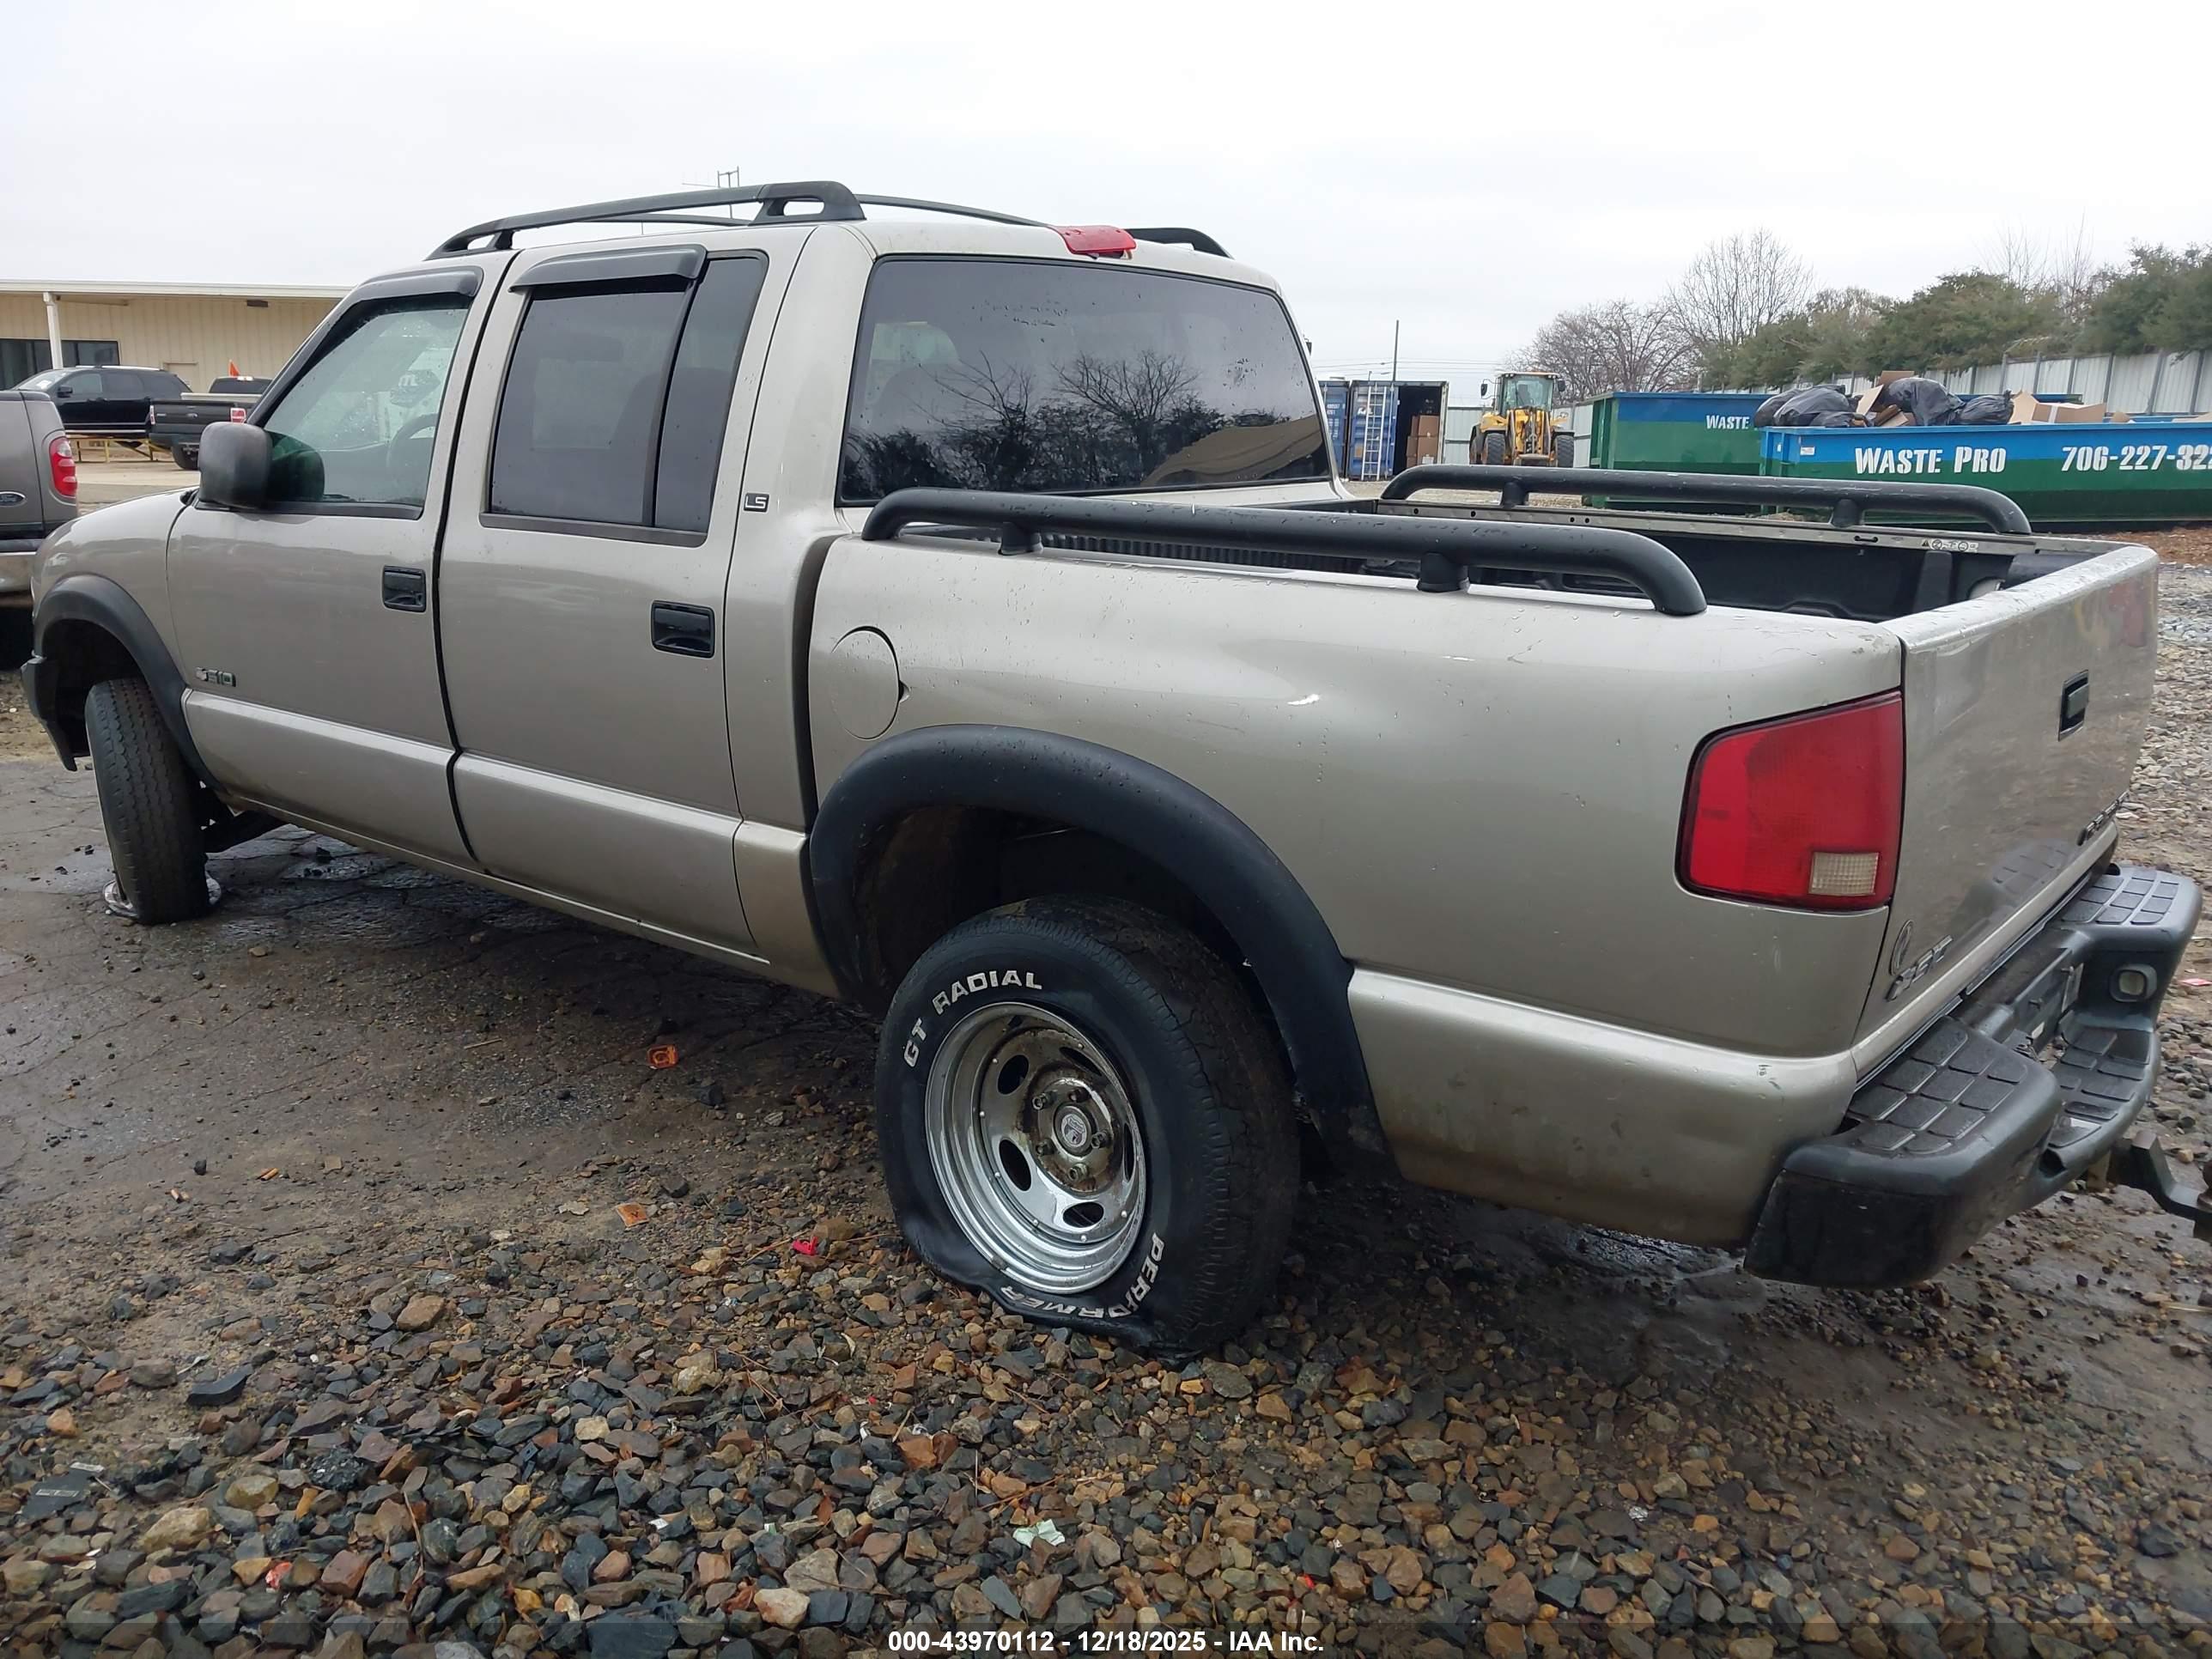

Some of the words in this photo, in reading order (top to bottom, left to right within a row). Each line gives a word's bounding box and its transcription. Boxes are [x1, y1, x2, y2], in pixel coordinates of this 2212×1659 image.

[1705, 414, 1750, 430] WASTE
[1854, 447, 1944, 474] WASTE
[1954, 446, 2008, 474] PRO
[2061, 444, 2212, 471] 706-227-32
[744, 495, 767, 509] LS
[902, 1017, 928, 1068] GT
[931, 969, 1043, 1016] RADIAL
[1000, 1231, 1165, 1319] PERFORMER
